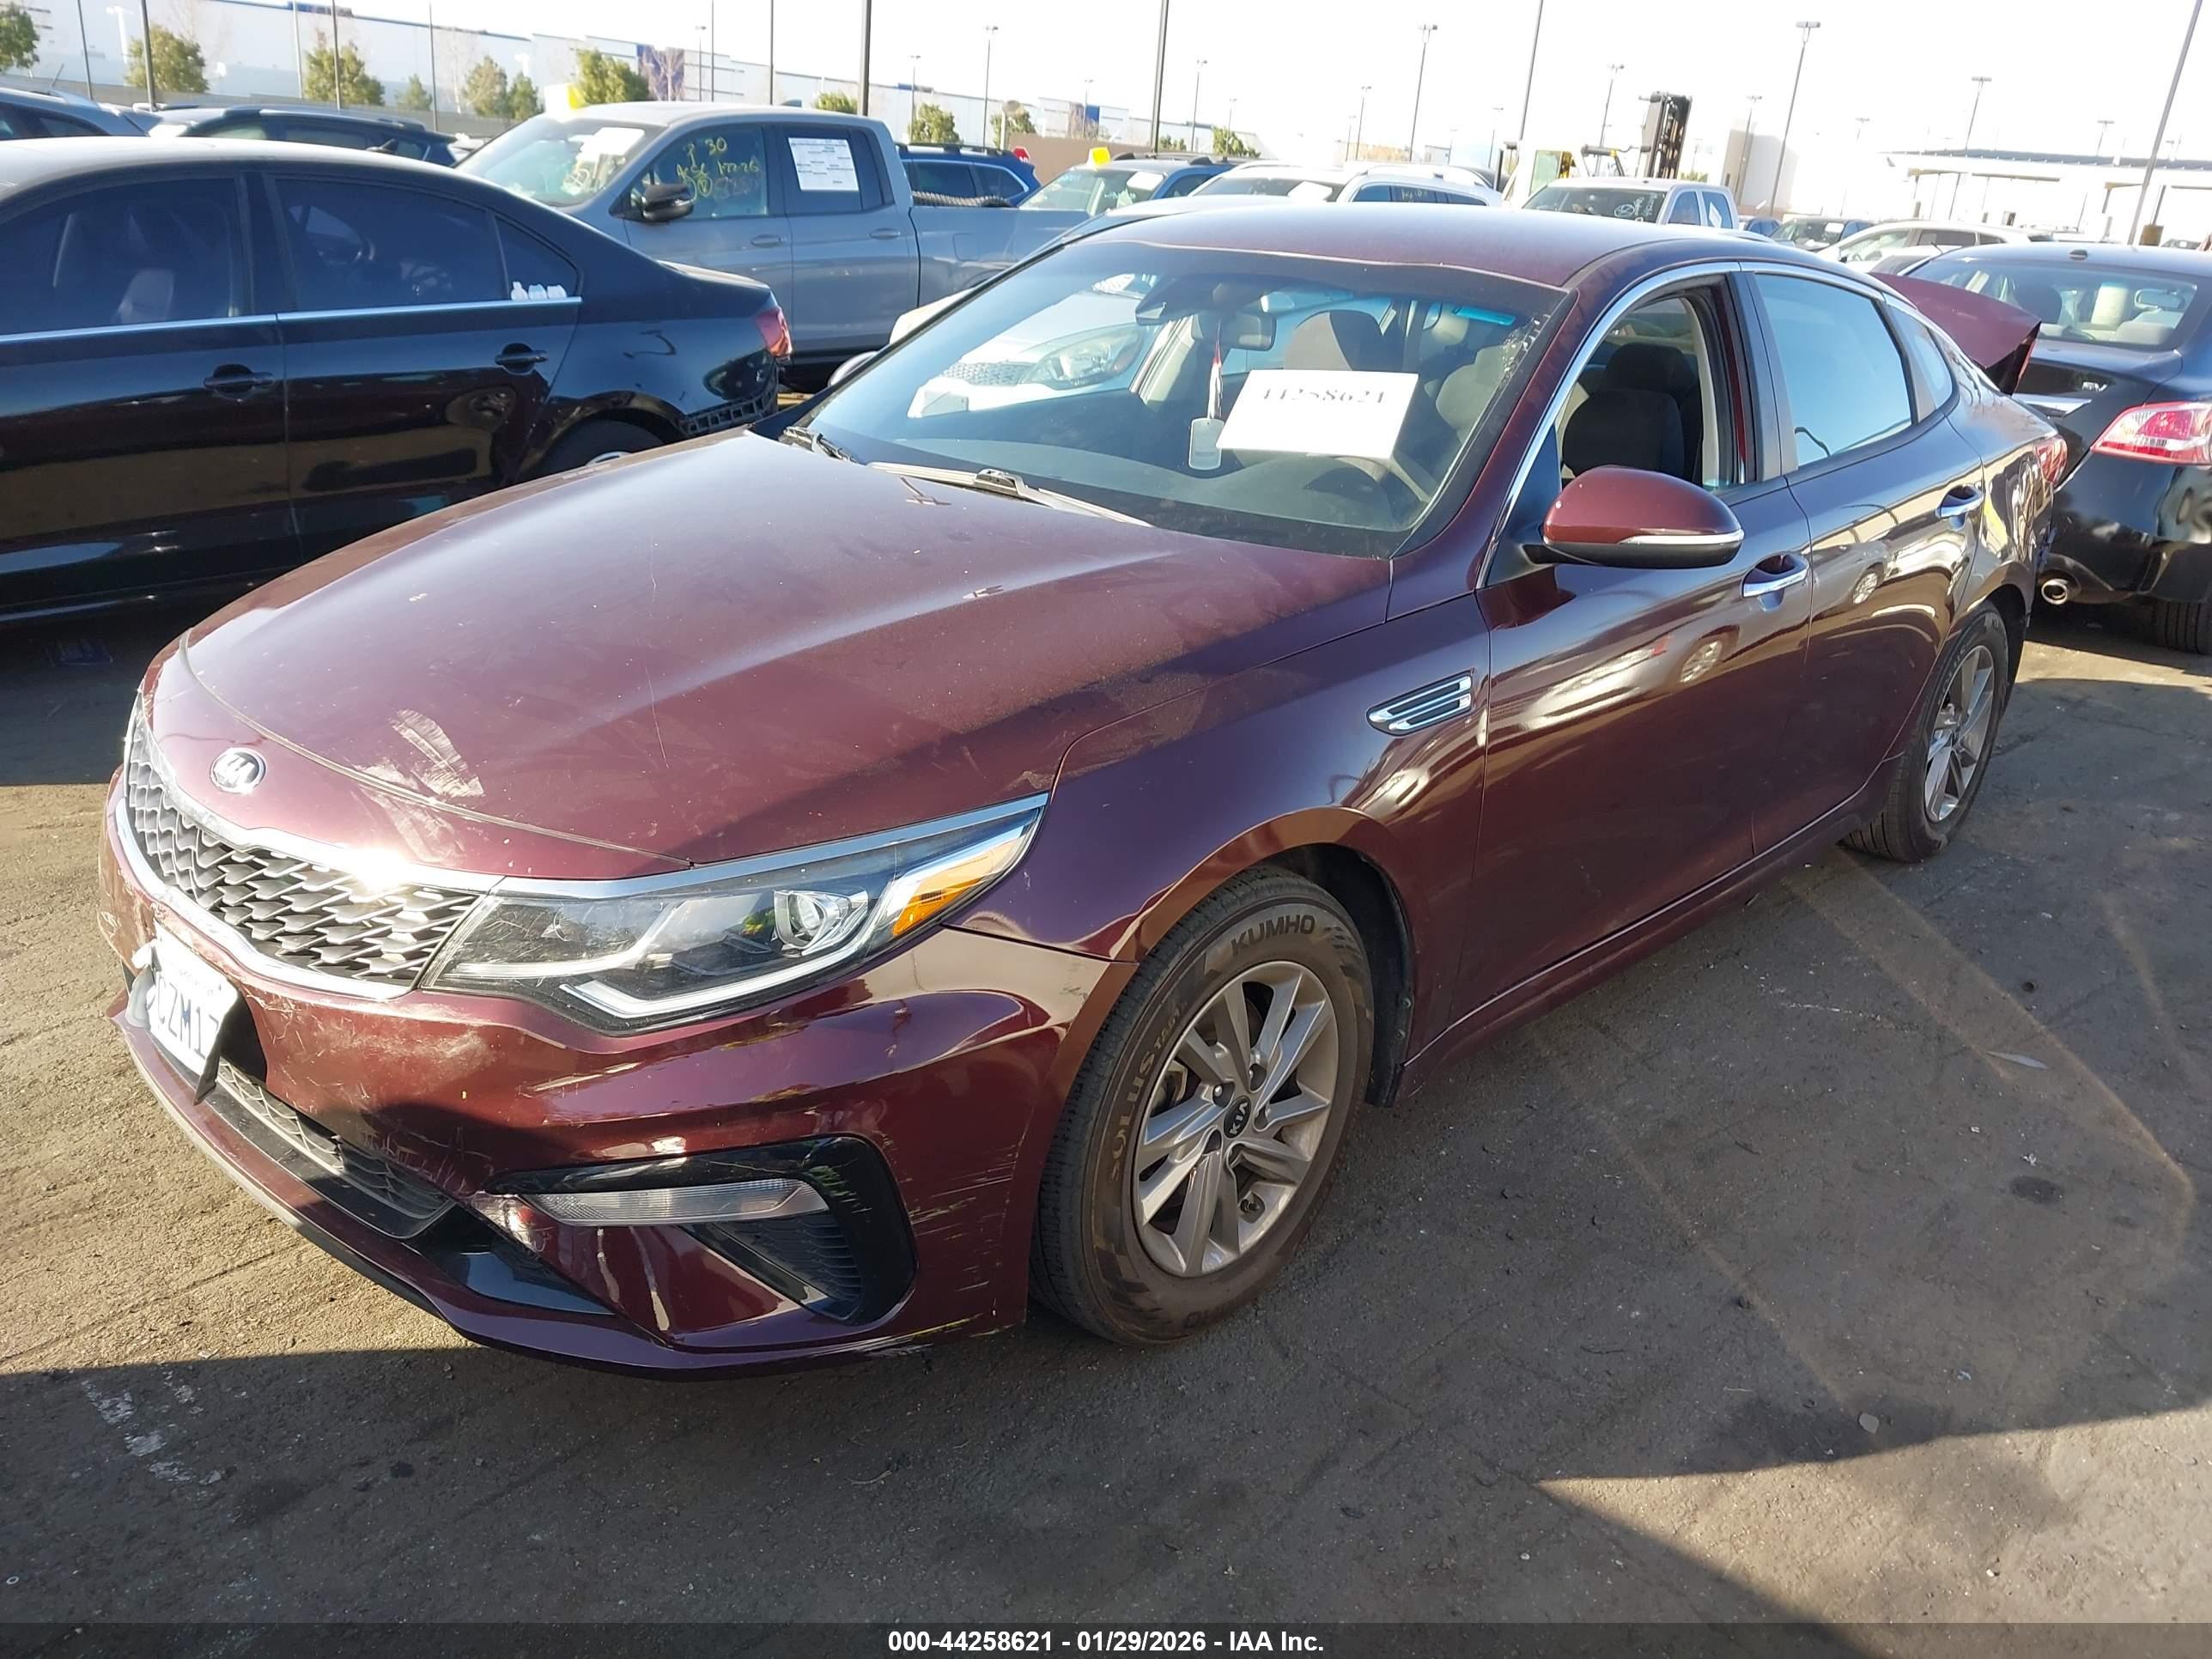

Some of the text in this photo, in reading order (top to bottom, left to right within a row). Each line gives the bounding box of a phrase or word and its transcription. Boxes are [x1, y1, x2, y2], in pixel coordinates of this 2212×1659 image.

[1231, 915, 1316, 956] KUMHO
[1110, 1050, 1156, 1182] SOLUS
[1229, 1101, 1249, 1135] KIA
